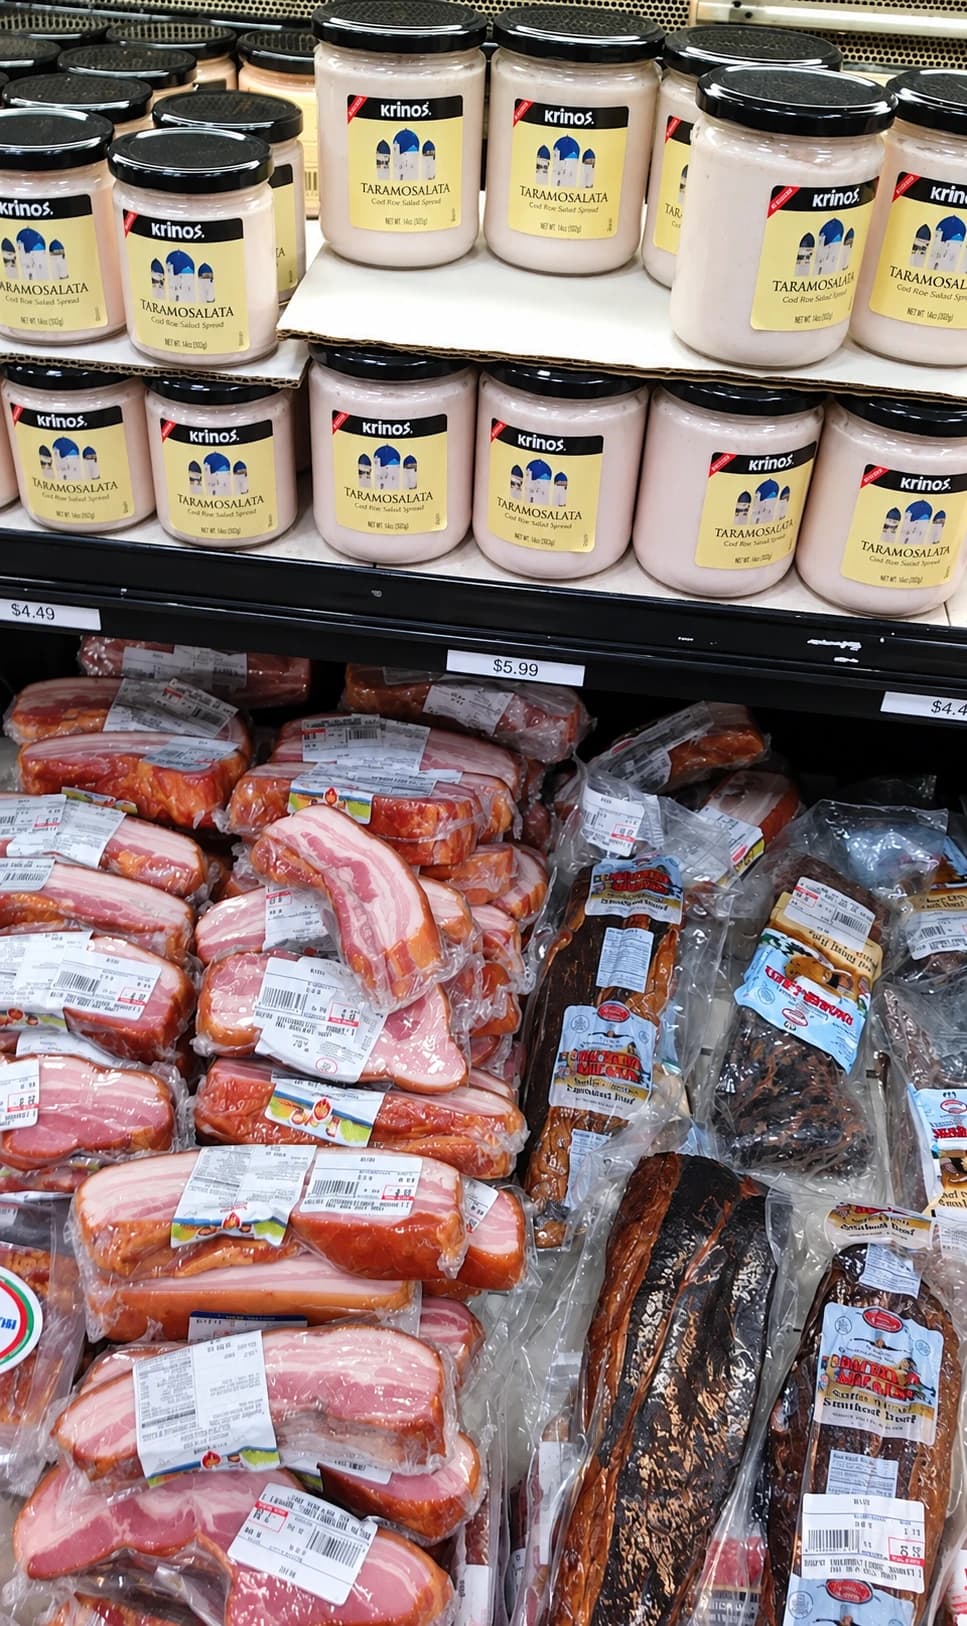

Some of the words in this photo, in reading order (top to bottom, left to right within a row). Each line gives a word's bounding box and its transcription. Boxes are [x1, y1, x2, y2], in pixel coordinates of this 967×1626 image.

[361, 182, 450, 198] TARAMOSALATA
[520, 186, 608, 203] TARAMOSALATA
[772, 272, 854, 293] TARAMOSALATA
[140, 299, 234, 317] TARAMOSALATA
[32, 478, 118, 493] TARAMOSALATA
[178, 494, 264, 510] TARAMOSALATA
[344, 487, 434, 504] TARAMOSALATA
[497, 497, 582, 520] TARAMOSALATA
[715, 519, 793, 538] TARAMOSALATA
[860, 541, 950, 559] TARAMOSALATA
[11, 603, 55, 621] $4.49
[493, 658, 538, 677] $5.99
